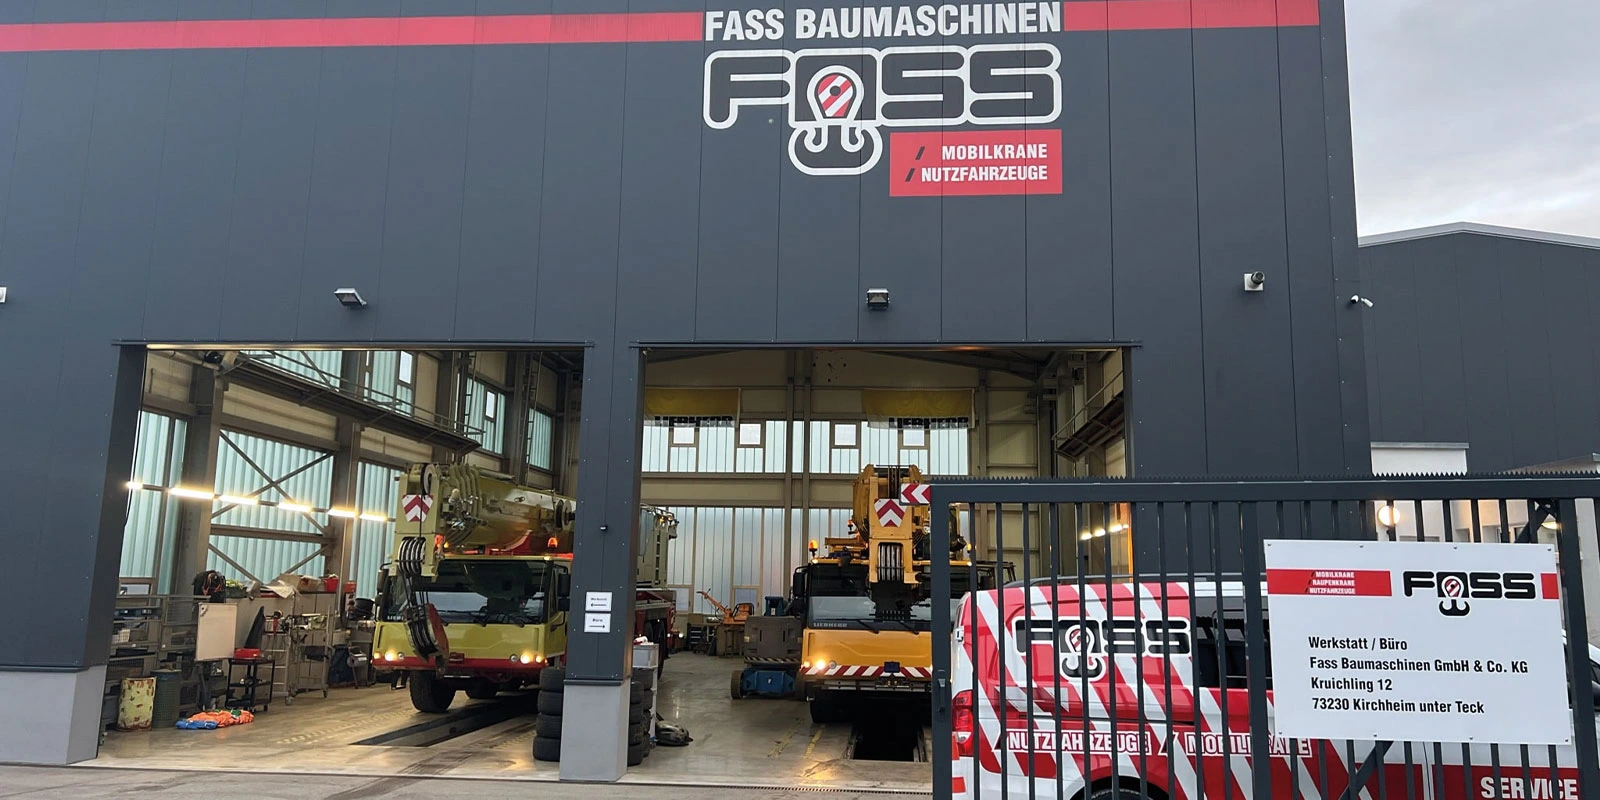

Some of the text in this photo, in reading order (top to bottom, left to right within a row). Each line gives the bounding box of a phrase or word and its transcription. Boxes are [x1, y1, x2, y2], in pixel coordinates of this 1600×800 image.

[705, 2, 1061, 41] FASS BAUMASCHINEN
[703, 43, 1062, 129] FASS
[941, 144, 1048, 161] MOBILKRANE
[921, 165, 1048, 183] NUTZFAHRZEUGE
[1402, 570, 1537, 599] FASS
[1308, 636, 1368, 650] Werkstatt
[1379, 637, 1408, 651] Büro
[1310, 657, 1529, 674] Fass Baumaschinen GmbH & Co. KG
[1311, 677, 1393, 693] Kruichling 12
[1312, 698, 1485, 714] 73230 Kirchheim unter Teck
[1188, 734, 1309, 755] MOBILAE
[1480, 776, 1579, 800] SERVICE
